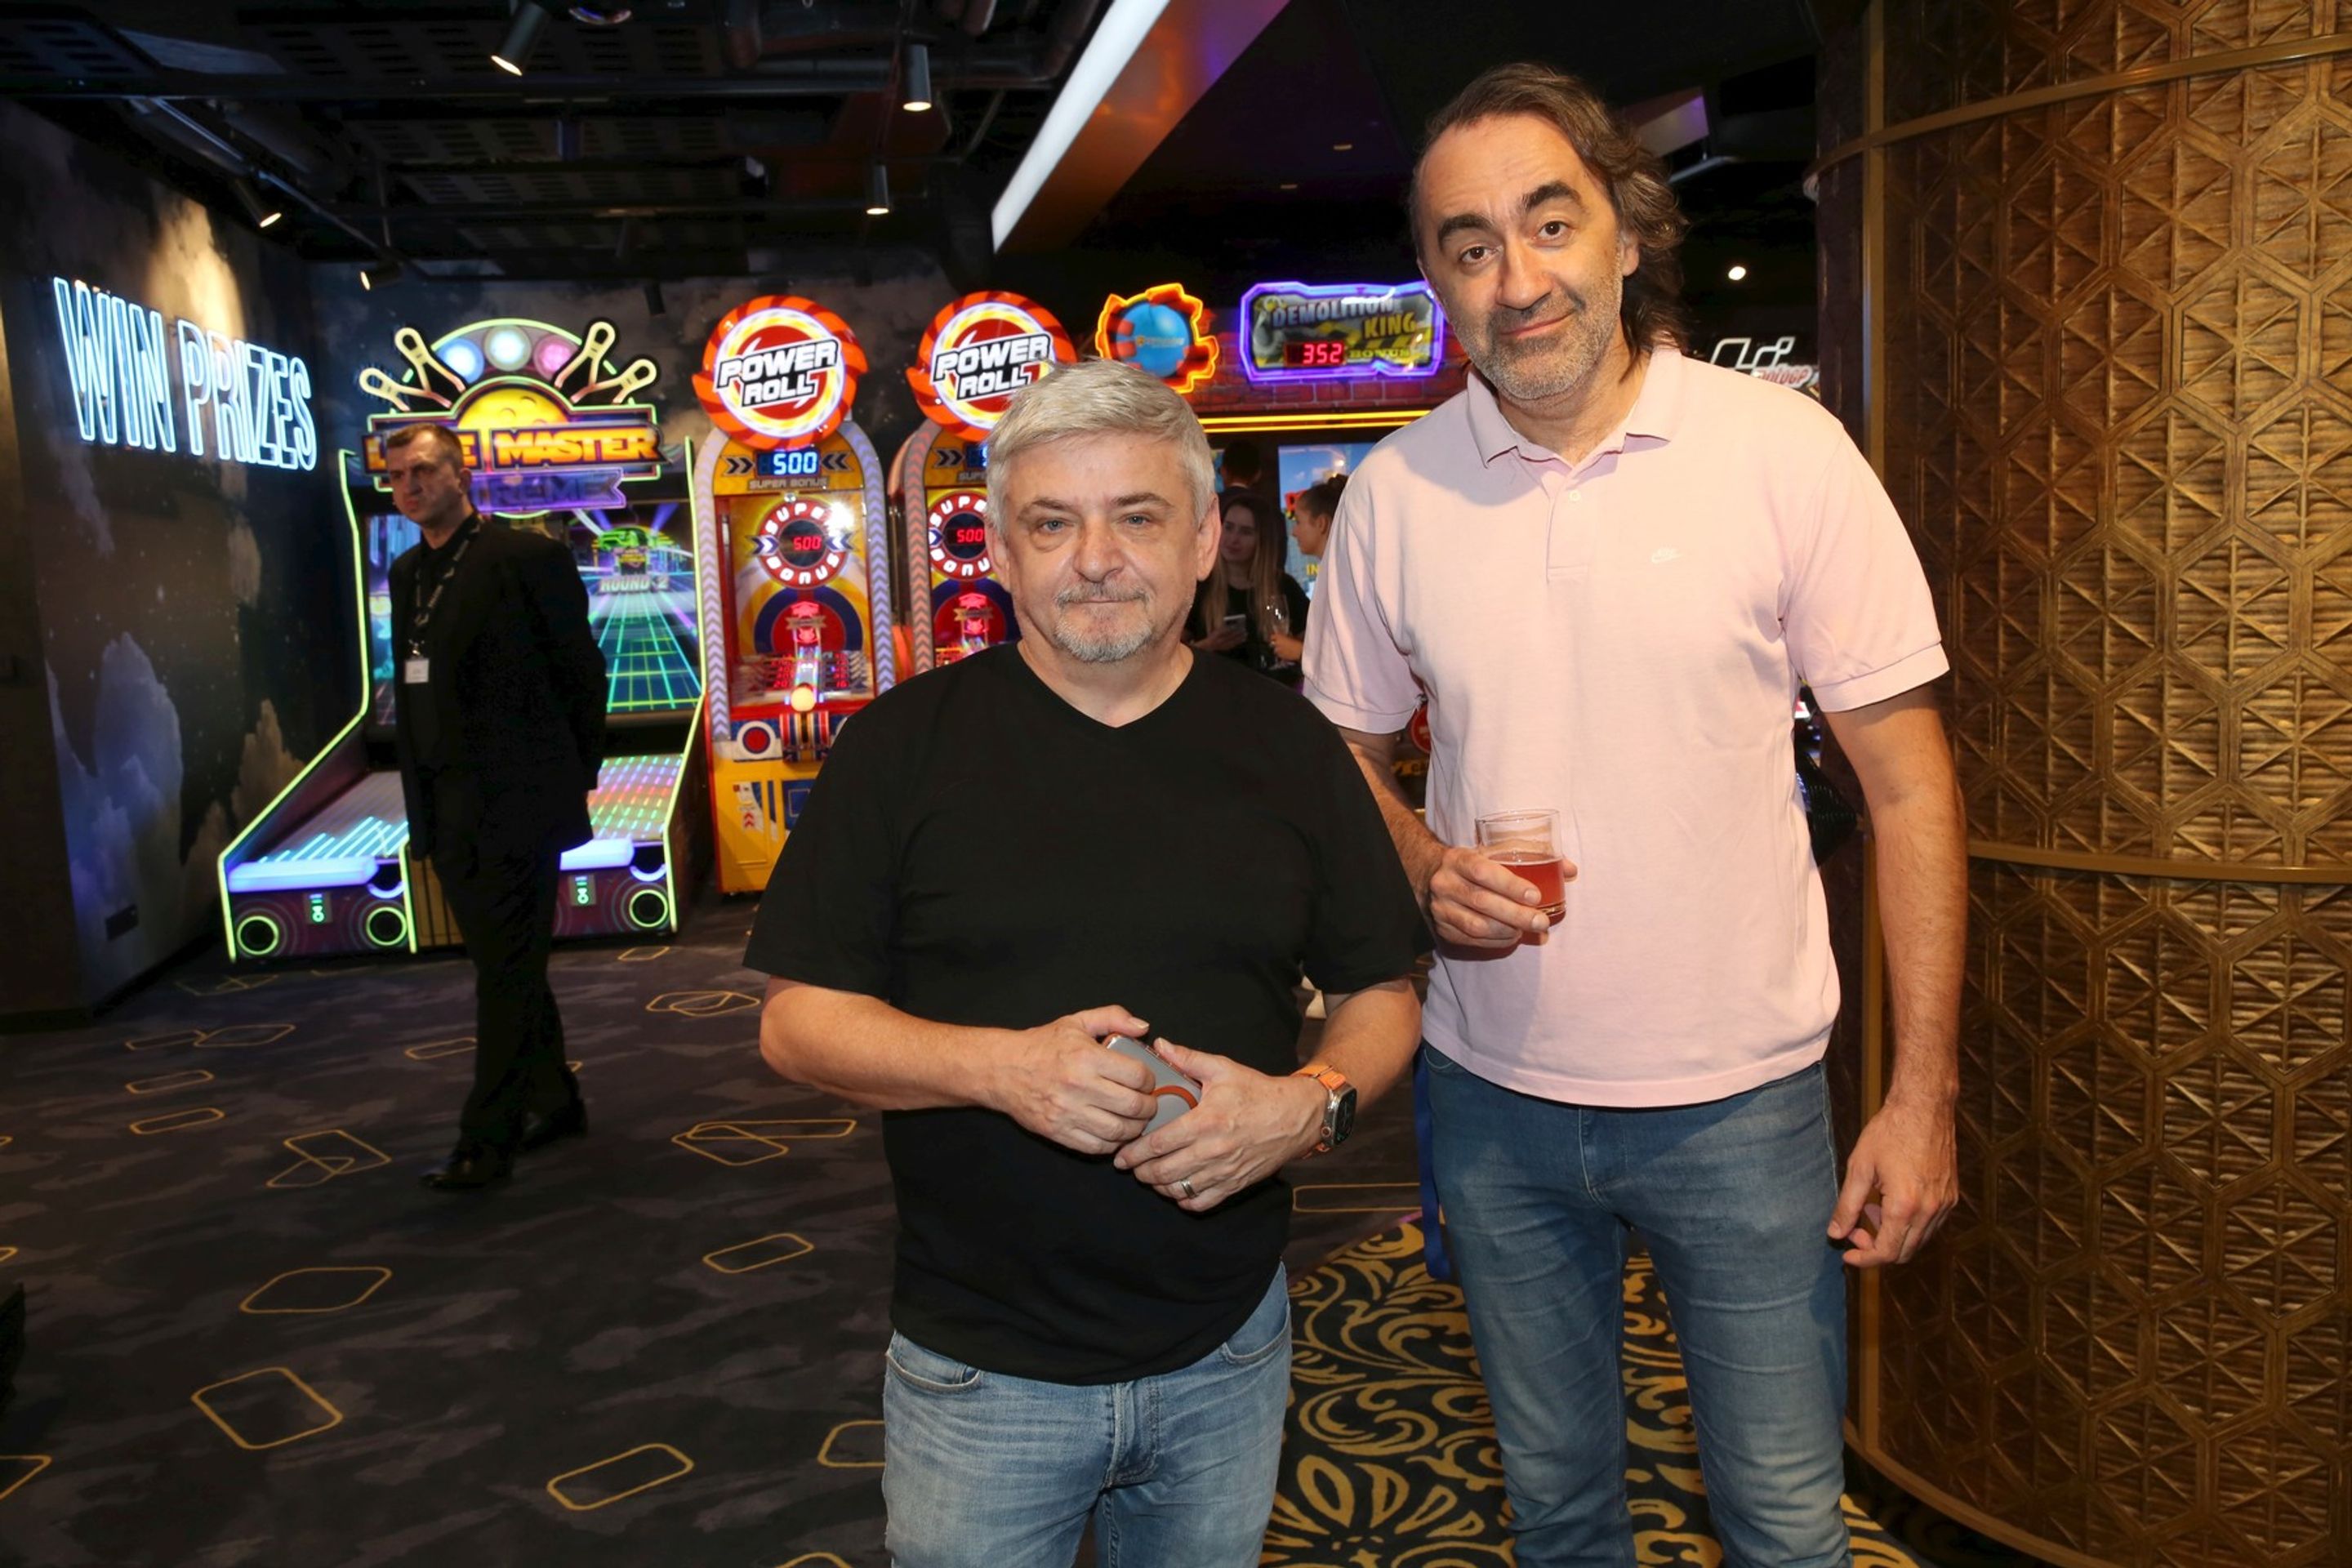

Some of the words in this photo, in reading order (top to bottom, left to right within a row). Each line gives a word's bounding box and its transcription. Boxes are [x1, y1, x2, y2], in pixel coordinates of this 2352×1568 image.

[1272, 297, 1403, 327] DEMOLITION
[1364, 312, 1416, 339] KING
[718, 341, 838, 387] POWER
[935, 335, 1049, 381] POWER
[1303, 343, 1343, 364] 352
[1349, 348, 1410, 359] BONUS
[54, 277, 176, 452] WIN
[177, 319, 317, 471] PRIZES
[958, 366, 1027, 399] ROLL
[742, 373, 814, 406] ROLL
[364, 435, 477, 468] LE
[493, 427, 660, 466] MASTER
[773, 452, 818, 475] 500
[958, 471, 987, 481] SUP
[749, 479, 787, 489] SUPER
[791, 478, 827, 488] BONUS
[929, 495, 989, 528] SUPE
[793, 536, 822, 550] 500
[956, 528, 985, 543] 500
[929, 548, 991, 577] BONU
[600, 576, 650, 591] ROUND
[657, 575, 669, 589] 2
